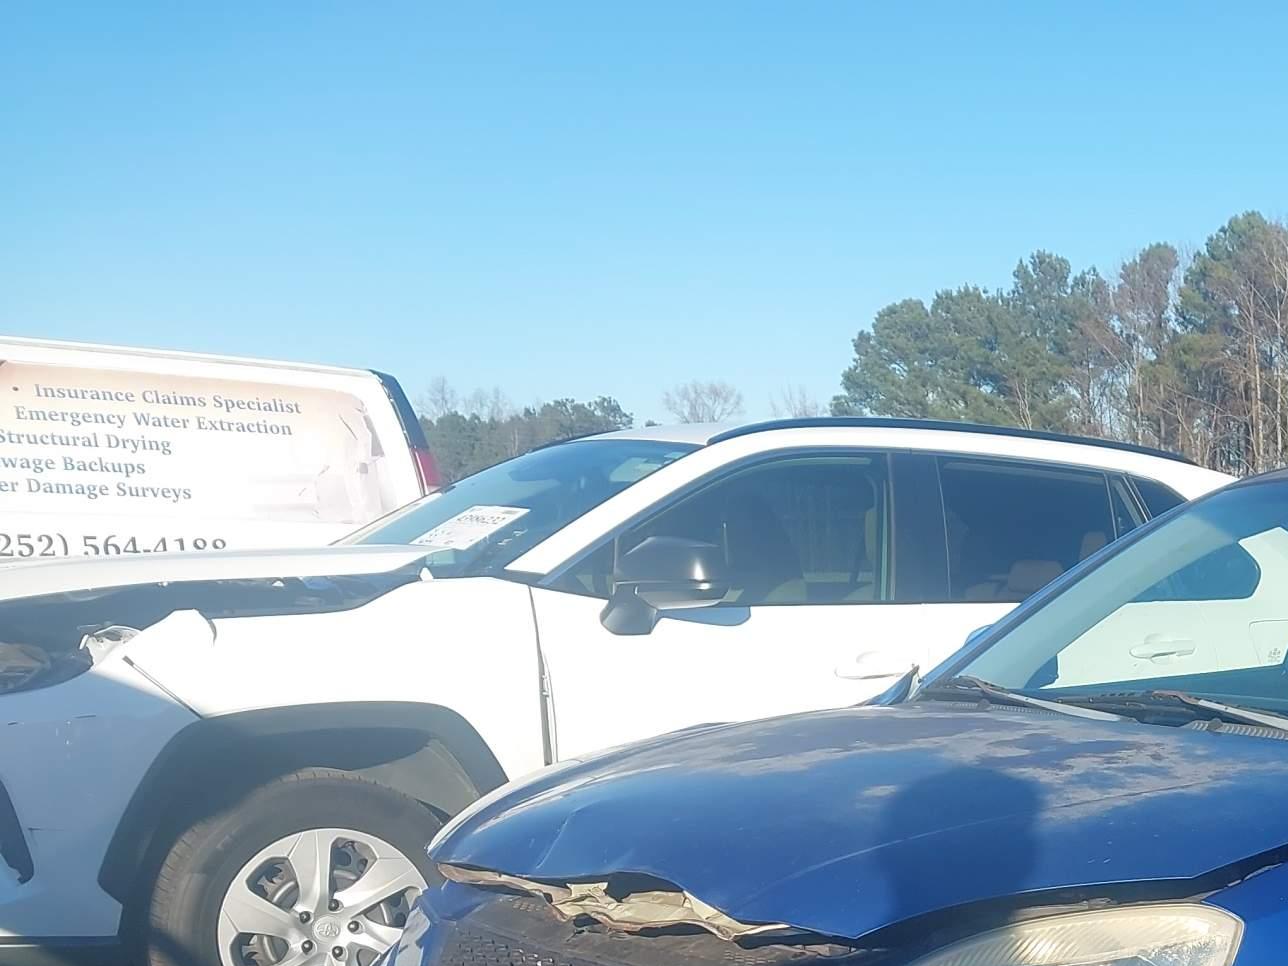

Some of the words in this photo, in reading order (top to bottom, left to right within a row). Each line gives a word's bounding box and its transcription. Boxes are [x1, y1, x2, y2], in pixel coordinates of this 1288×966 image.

[34, 383, 136, 402] Insurance
[142, 390, 207, 408] Claims
[212, 394, 302, 414] Specialist
[14, 405, 126, 429] Emergency
[132, 412, 190, 429] Water
[196, 416, 293, 436] Extraction
[0, 428, 99, 448] Structural
[104, 433, 172, 456] Drying
[0, 456, 57, 474] wage
[62, 456, 146, 478] Backups
[26, 477, 110, 500] Damage
[116, 482, 192, 503] Surveys
[0, 532, 69, 558] 252)
